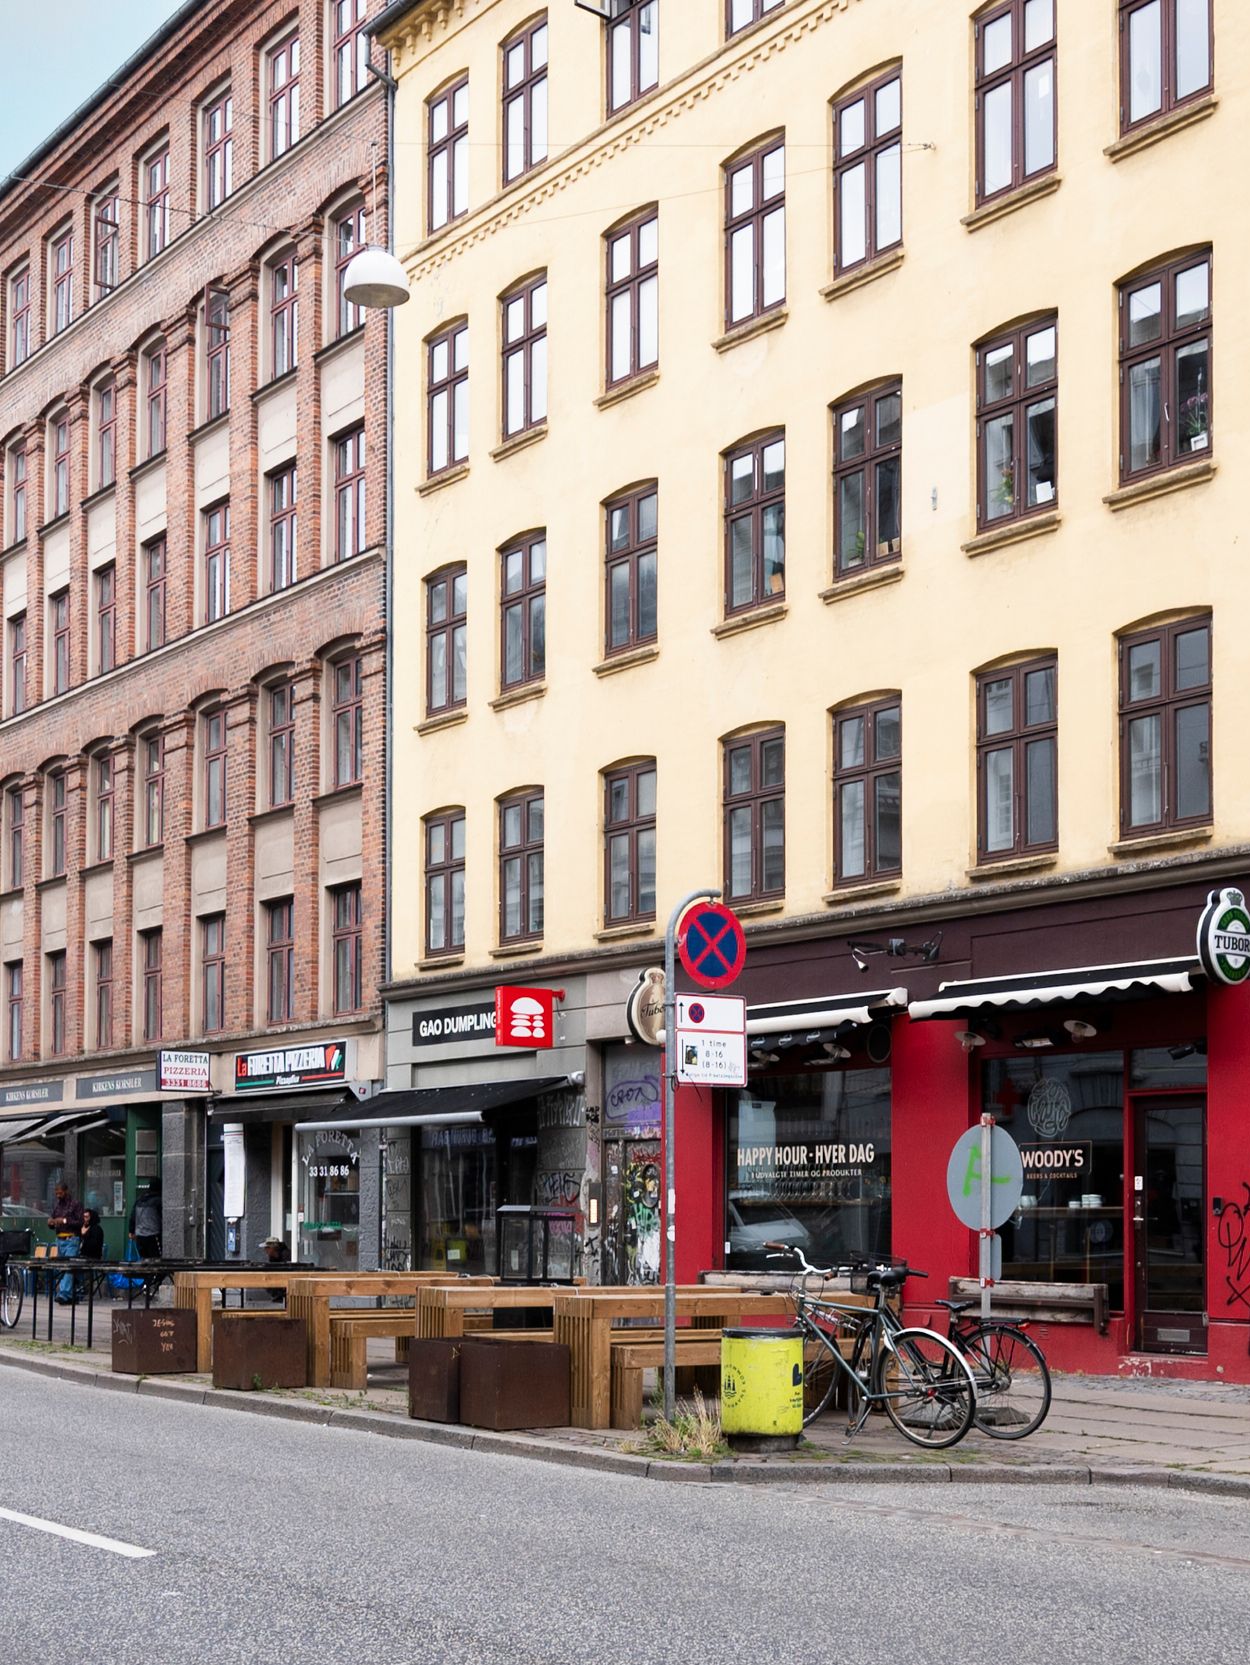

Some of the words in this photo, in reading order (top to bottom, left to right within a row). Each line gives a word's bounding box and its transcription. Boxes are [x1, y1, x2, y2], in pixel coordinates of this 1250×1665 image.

[641, 1001, 666, 1017] Tubo
[419, 1018, 442, 1037] GAO
[162, 1053, 172, 1062] LA
[174, 1054, 208, 1064] FORETTA
[237, 1056, 247, 1077] La
[247, 1052, 285, 1076] FORETTA
[285, 1046, 325, 1072] PIZZERIA
[163, 1066, 207, 1076] PIZZERIA
[92, 1079, 115, 1093] KIRKENS
[315, 1129, 361, 1165] FORETTA
[737, 1147, 772, 1166] HAPPY
[775, 1146, 808, 1166] HOUR
[815, 1144, 846, 1164] HVER
[849, 1143, 875, 1163] DAG
[1021, 1149, 1084, 1168] WOODY'S
[309, 1166, 318, 1177] 33
[319, 1166, 328, 1177] 31
[329, 1165, 339, 1176] 86
[340, 1165, 350, 1176] 86
[755, 1171, 787, 1179] UDVALGTE
[789, 1170, 809, 1178] TIMER
[822, 1168, 862, 1177] PRODUKTER
